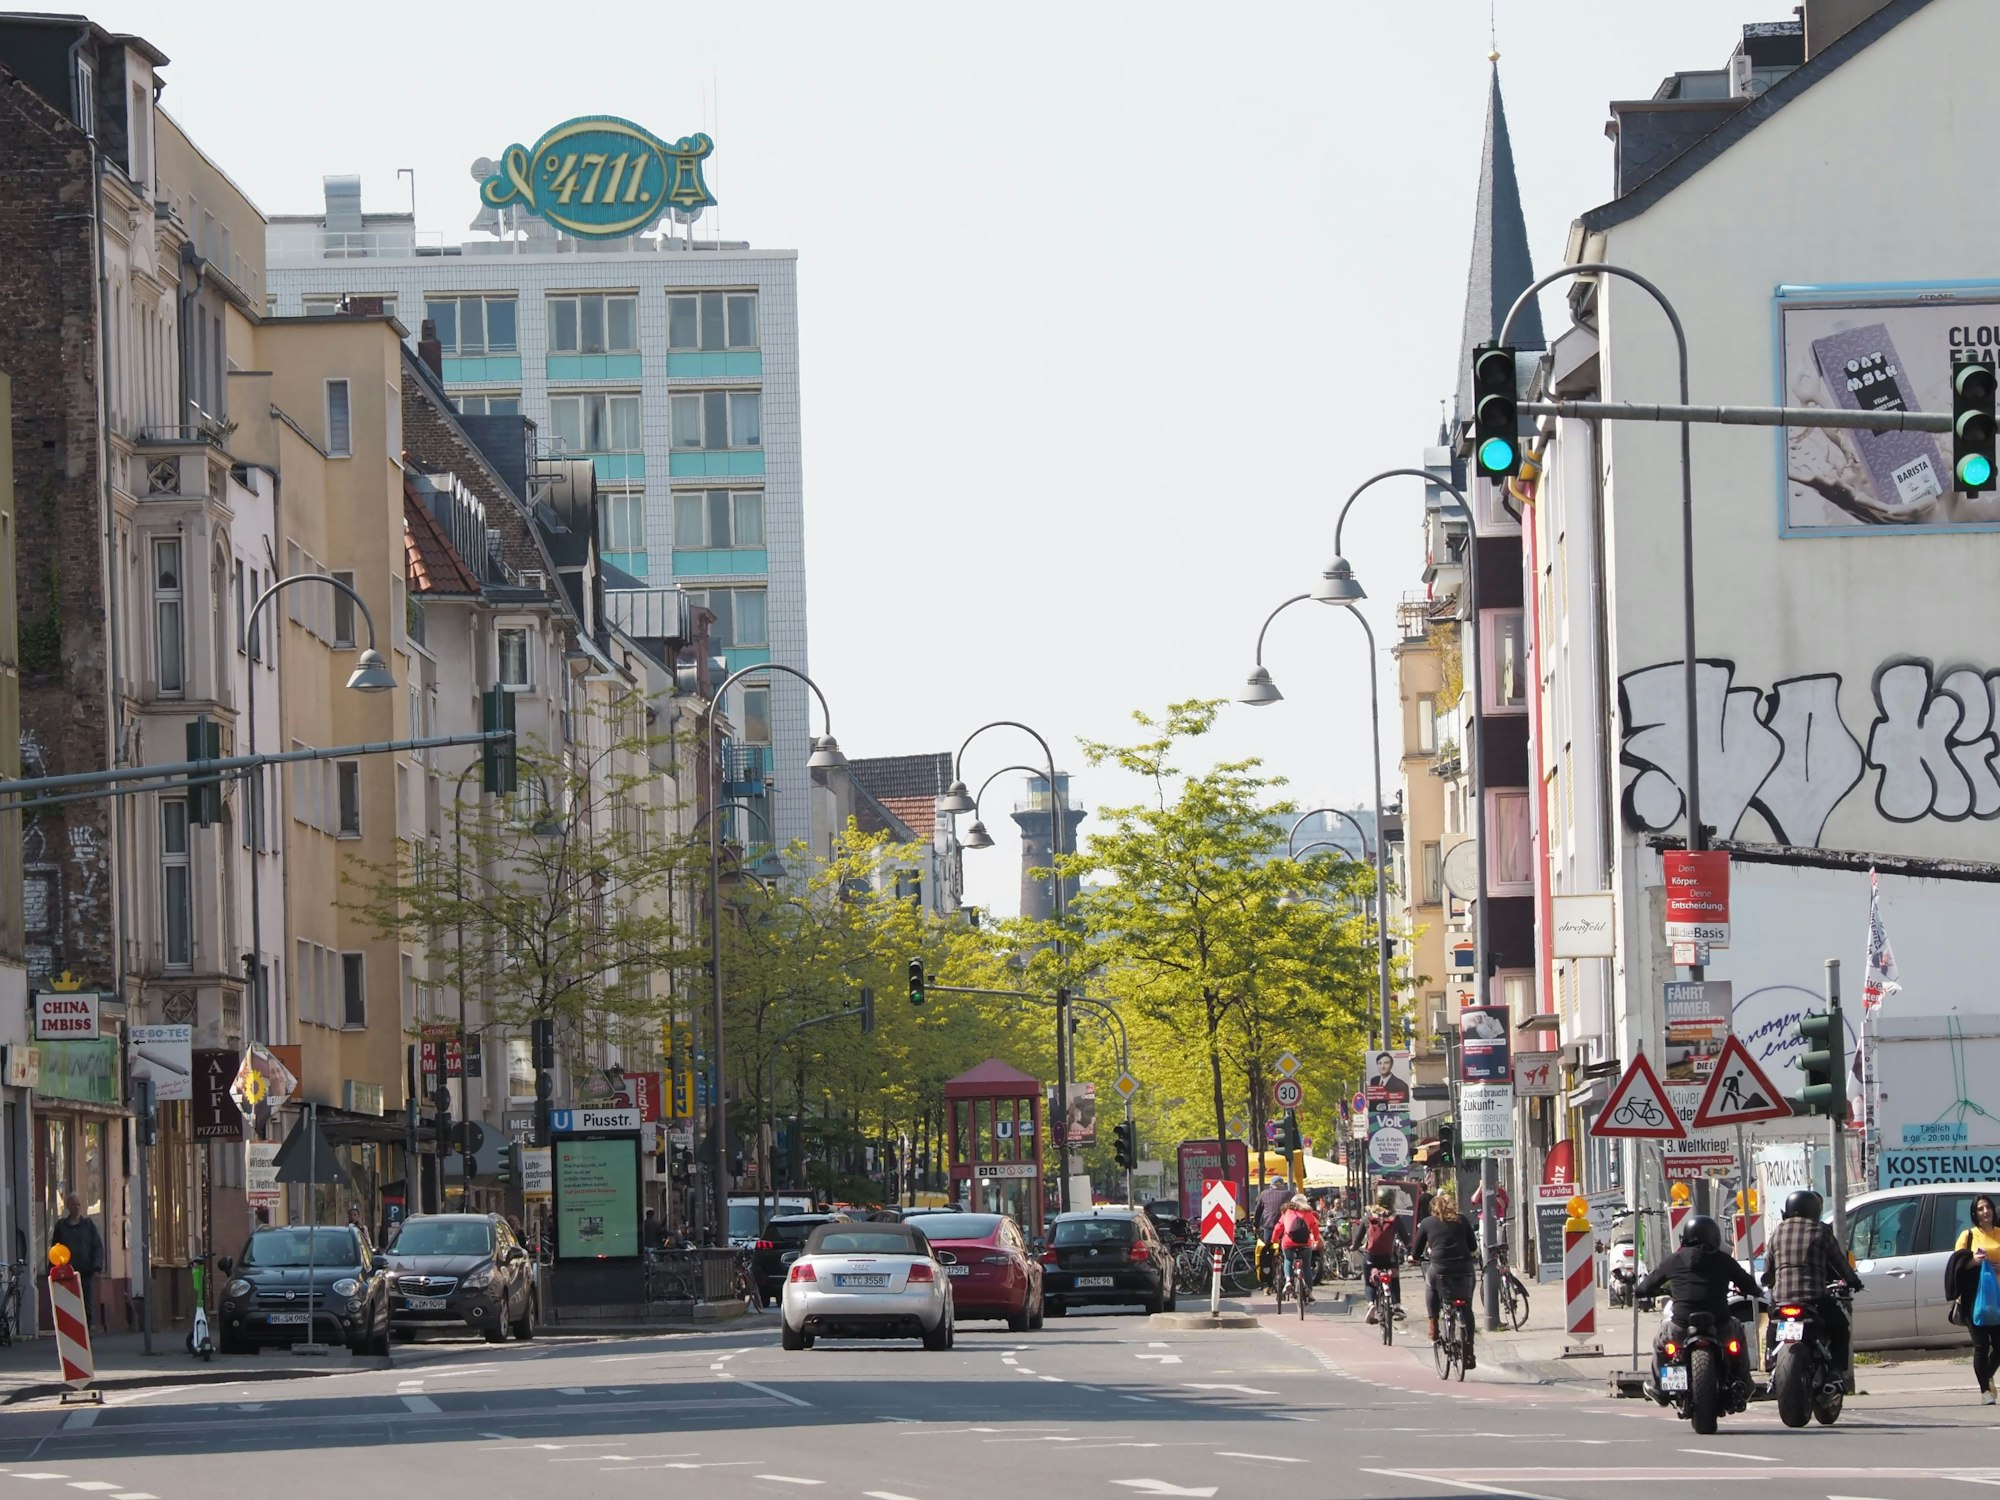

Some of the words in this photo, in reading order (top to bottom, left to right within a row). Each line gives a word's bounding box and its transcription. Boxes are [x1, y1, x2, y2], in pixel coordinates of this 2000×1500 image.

[1847, 352, 1882, 372] OAT
[1897, 461, 1929, 484] BARISTA
[1679, 864, 1695, 872] Dein
[1672, 877, 1699, 886] Körper.
[1690, 889, 1712, 897] Deine
[1672, 901, 1725, 911] Entscheidung.
[1680, 927, 1724, 939] dieBasis
[1668, 986, 1704, 1000] FÄHRT
[43, 1001, 90, 1014] CHINA
[1669, 1001, 1710, 1014] IMMER
[41, 1019, 92, 1031] IMBISS
[131, 1028, 189, 1038] KE-BO-TEC
[424, 1043, 462, 1056] PIZA
[207, 1052, 224, 1125] ALFI
[1280, 1087, 1296, 1099] 30
[1484, 1089, 1508, 1097] braucht
[1464, 1100, 1495, 1111] Zukunft
[511, 1120, 535, 1129] MEL
[583, 1114, 632, 1126] Piusstr.
[1377, 1115, 1402, 1127] Volt
[197, 1125, 240, 1136] PIZZERIA
[997, 1122, 1012, 1138] U
[1464, 1124, 1506, 1138] STOPPEN!
[1920, 1124, 1950, 1133] Täglich
[1928, 1134, 1950, 1142] 20:00
[1952, 1133, 1967, 1141] Uhr
[1667, 1141, 1675, 1151] 3.
[1678, 1138, 1730, 1153] Weltkrieg!
[1465, 1148, 1488, 1157] MLPD
[525, 1161, 542, 1169] Lohn-
[1183, 1155, 1236, 1167] MODEHS
[525, 1170, 551, 1178] nachsch
[1667, 1168, 1699, 1178] MLPD
[525, 1179, 541, 1188] jetzt!
[944, 1266, 969, 1275] 1759E
[864, 1275, 884, 1285] 3558
